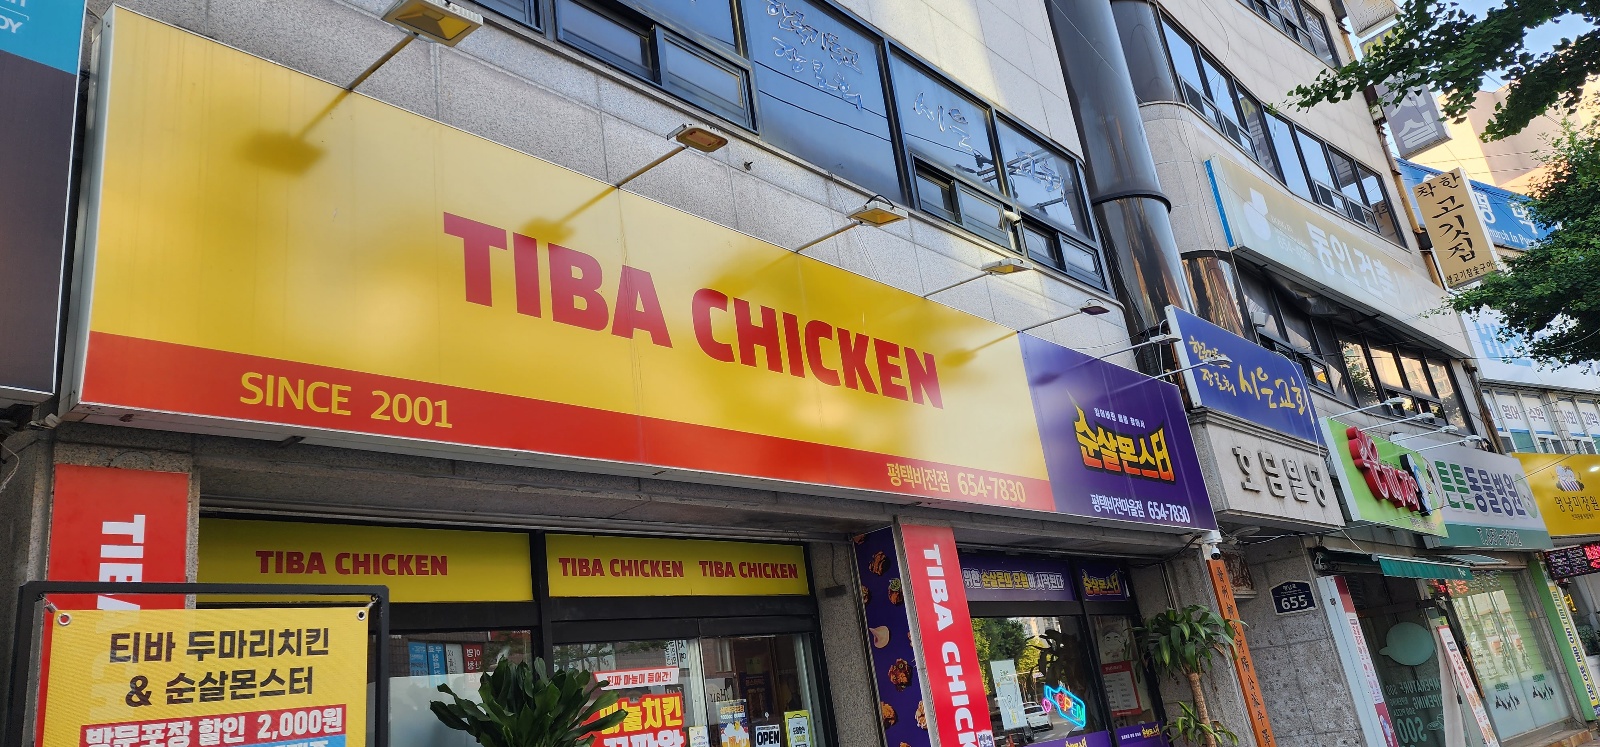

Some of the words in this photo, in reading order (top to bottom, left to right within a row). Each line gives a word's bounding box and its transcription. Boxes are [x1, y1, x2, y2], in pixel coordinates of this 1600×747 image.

[1418, 172, 1460, 198] 착한
[1432, 196, 1477, 263] 고깃집
[444, 211, 673, 349] TIBA
[691, 288, 944, 410] CHICKEN
[240, 371, 352, 416] SINCE
[370, 390, 453, 429] 2001
[1501, 404, 1522, 421] 영어
[1528, 405, 1546, 423] 수학
[1072, 396, 1175, 482] 순살몬스터
[886, 463, 950, 493] 평택비전점
[957, 472, 1026, 503] 654-7830
[1435, 460, 1528, 520] 튼튼동물병원
[1090, 494, 1145, 518] 평택비전마을점
[1148, 501, 1190, 524] 654-7830
[255, 550, 327, 575] TIBA
[335, 552, 448, 577] CHICKEN
[558, 557, 605, 577] TIBA
[609, 558, 684, 578] CHICKEN
[699, 560, 736, 578] TIBA
[739, 561, 799, 579] CHICKEN
[923, 543, 954, 632] TIBA
[1082, 569, 1121, 596] 순살몬스터
[1281, 595, 1308, 610] 655
[109, 631, 176, 663] 티바
[186, 627, 329, 662] 두마리치킨
[125, 675, 152, 708] &
[165, 666, 313, 705] 순살몬스터
[623, 673, 646, 686] 마늘이
[647, 671, 672, 684] 들어간!
[1055, 691, 1085, 722] OPEN
[198, 715, 246, 746] 할인
[256, 707, 343, 740] 2,000원
[757, 729, 780, 747] OPEN
